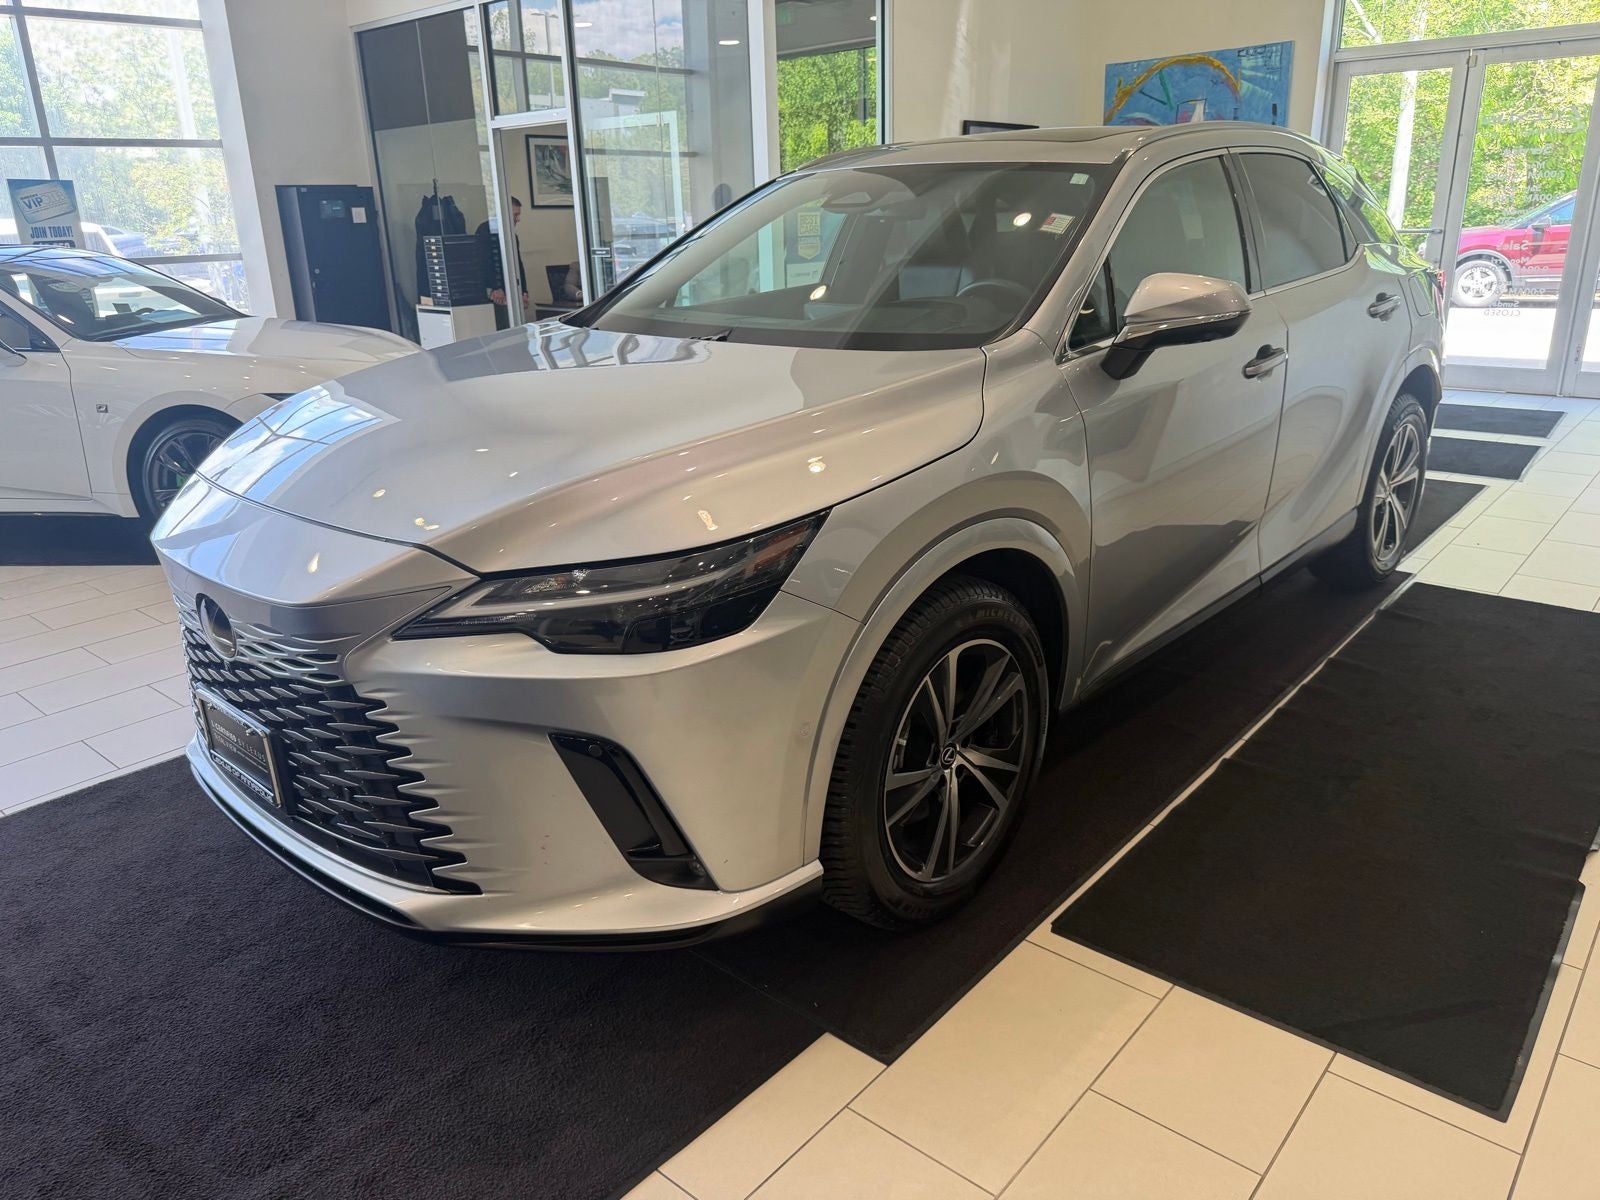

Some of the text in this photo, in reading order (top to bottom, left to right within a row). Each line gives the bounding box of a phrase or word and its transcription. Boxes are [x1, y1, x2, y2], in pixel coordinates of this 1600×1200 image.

[22, 196, 43, 210] VIP
[30, 225, 74, 239] JOIN TODAY!
